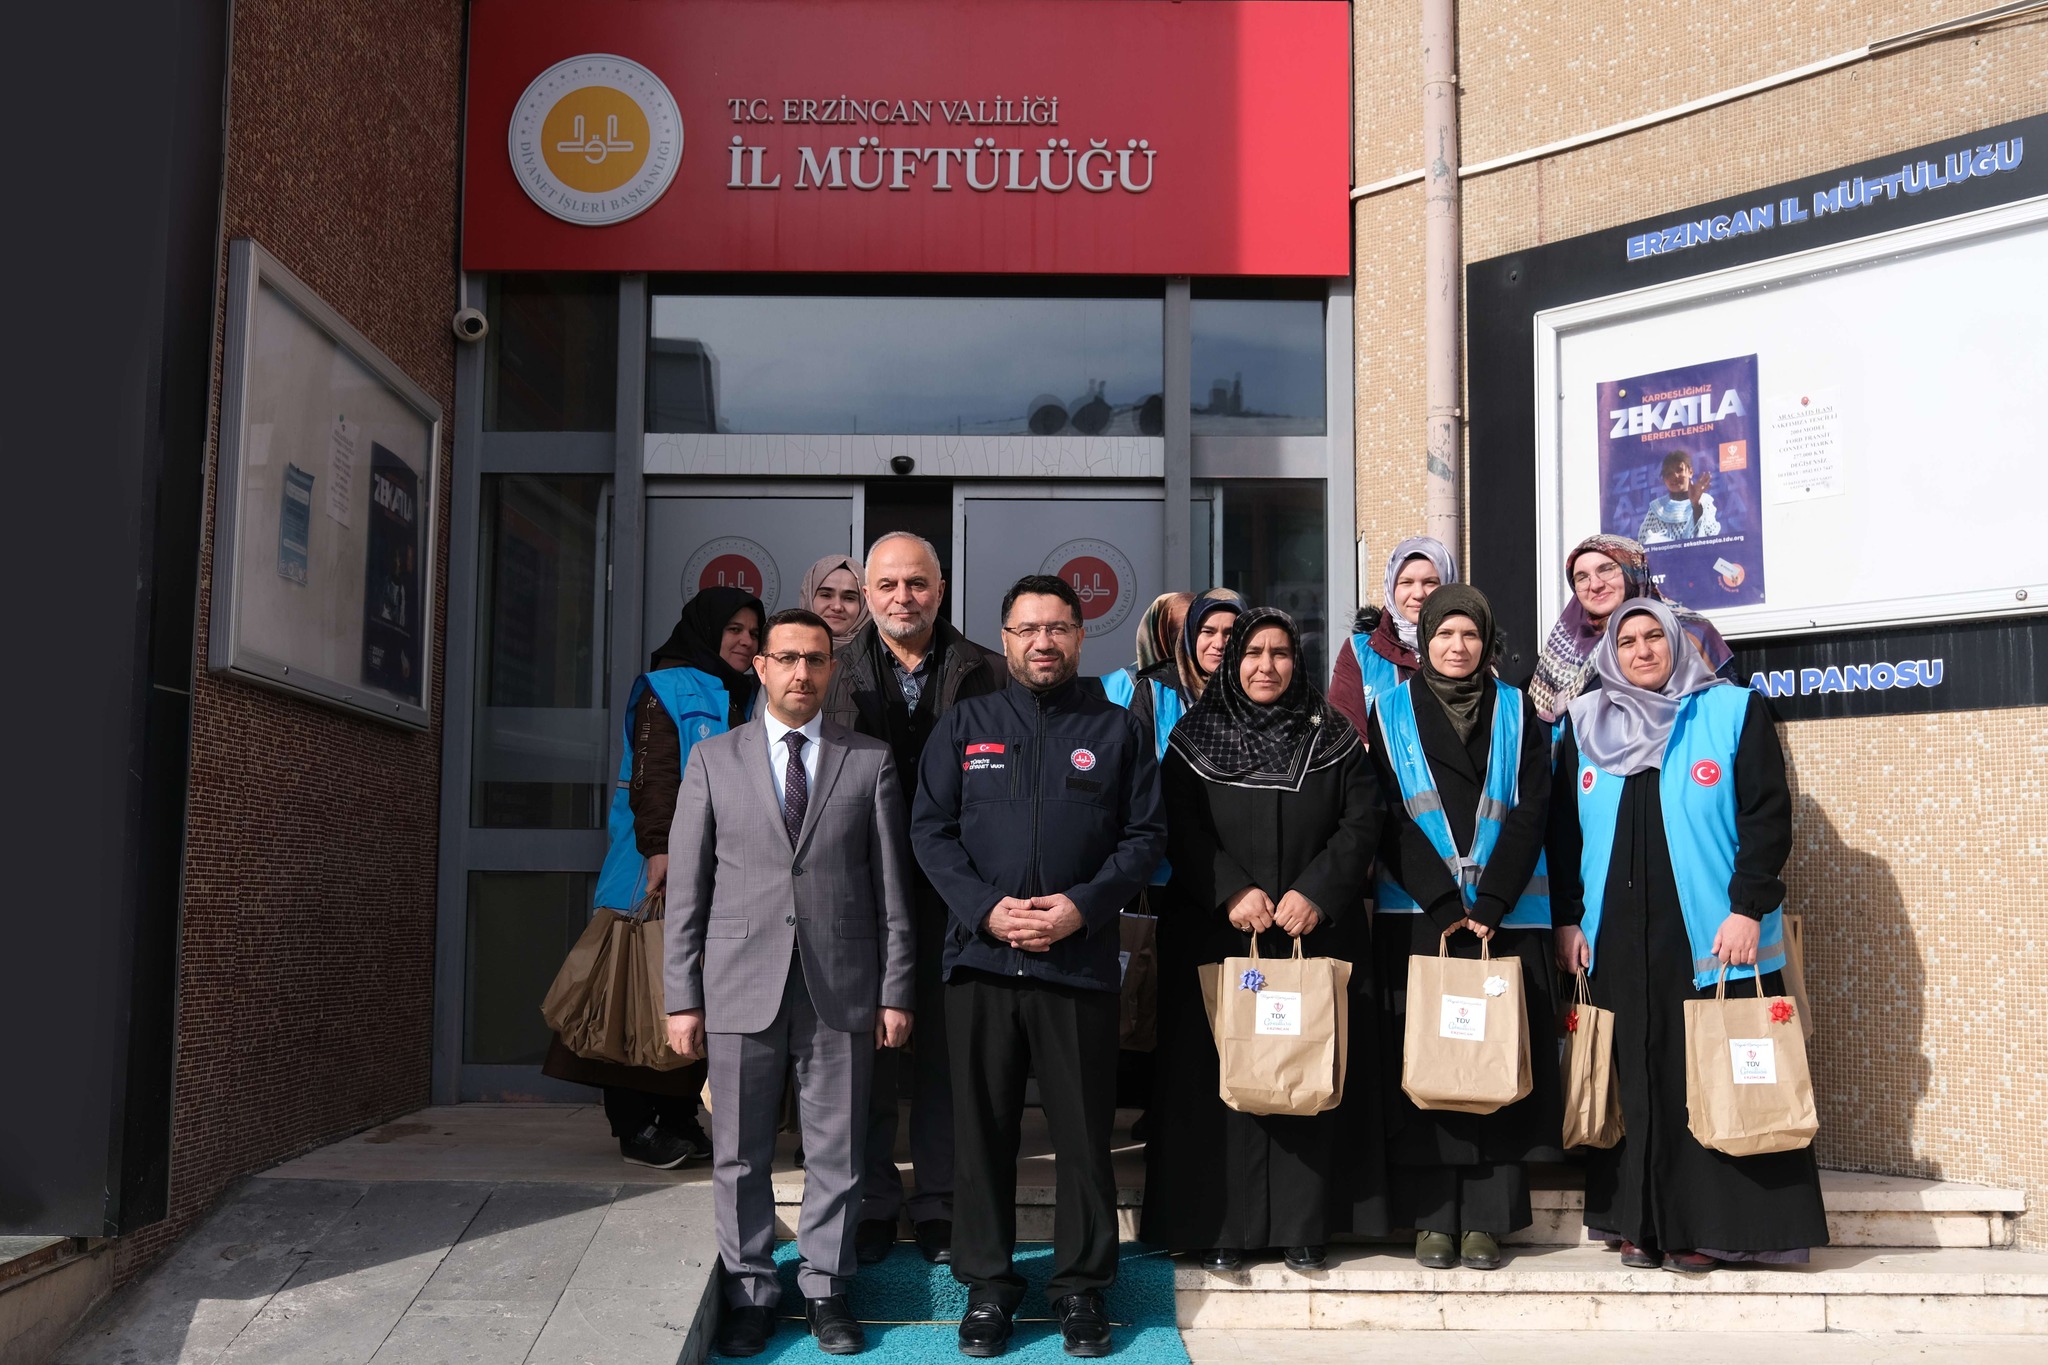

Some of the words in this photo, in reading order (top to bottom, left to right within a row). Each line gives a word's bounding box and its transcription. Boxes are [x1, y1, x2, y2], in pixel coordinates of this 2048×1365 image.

[727, 98, 774, 124] T.C.
[782, 94, 933, 125] ERZİNCAN
[939, 95, 1059, 126] VALİLİĞİ
[520, 141, 558, 199] DİYANET
[558, 192, 606, 213] İŞLERİ
[610, 140, 671, 211] BAŞKANLIĞI
[727, 135, 782, 190] İL
[794, 136, 1158, 193] MÜFTÜLÜĞÜ
[1627, 203, 1774, 261] ERZİNCAN
[1780, 197, 1808, 225] İL
[1813, 136, 2024, 218] MÜFTÜLÜĞÜ
[1609, 388, 1747, 439] ZEKATLA
[1642, 384, 1712, 404] KARDEŞLİĞİMİZ
[1641, 423, 1714, 443] BEREKETLENSİN
[1749, 669, 1795, 698] AN
[1800, 658, 1944, 696] PANOSU
